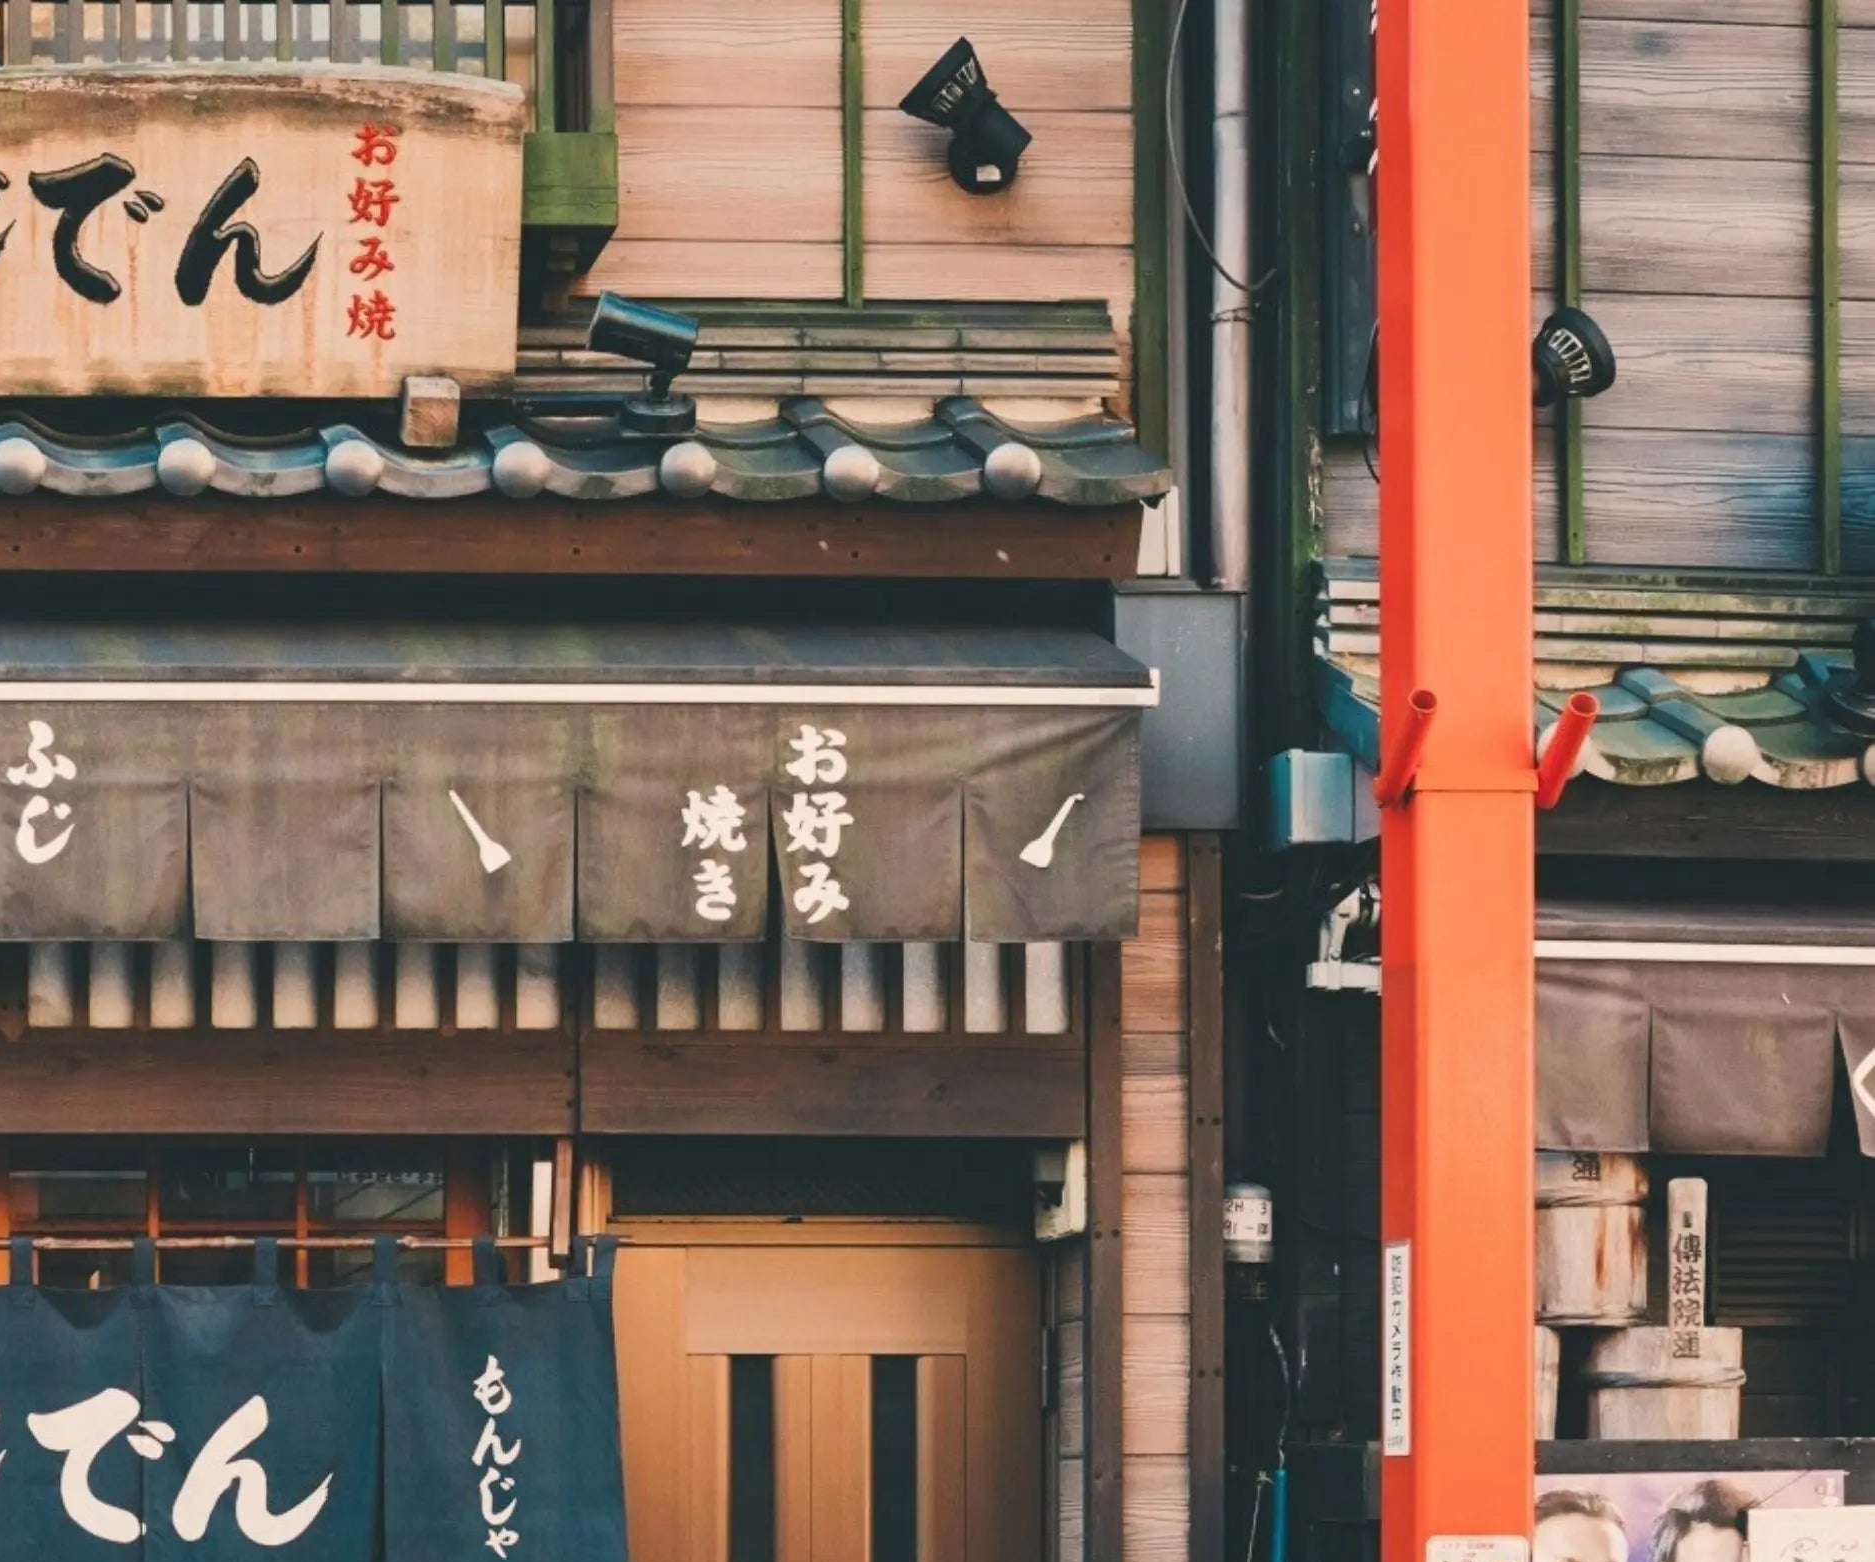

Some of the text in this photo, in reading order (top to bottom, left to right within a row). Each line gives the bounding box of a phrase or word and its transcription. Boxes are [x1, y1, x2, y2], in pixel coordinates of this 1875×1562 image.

[345, 120, 399, 340] お好み焼
[6, 720, 76, 864] ふじ
[680, 788, 749, 921] 焼き
[783, 724, 855, 923] お好み
[473, 1354, 522, 1561] もんじゃ
